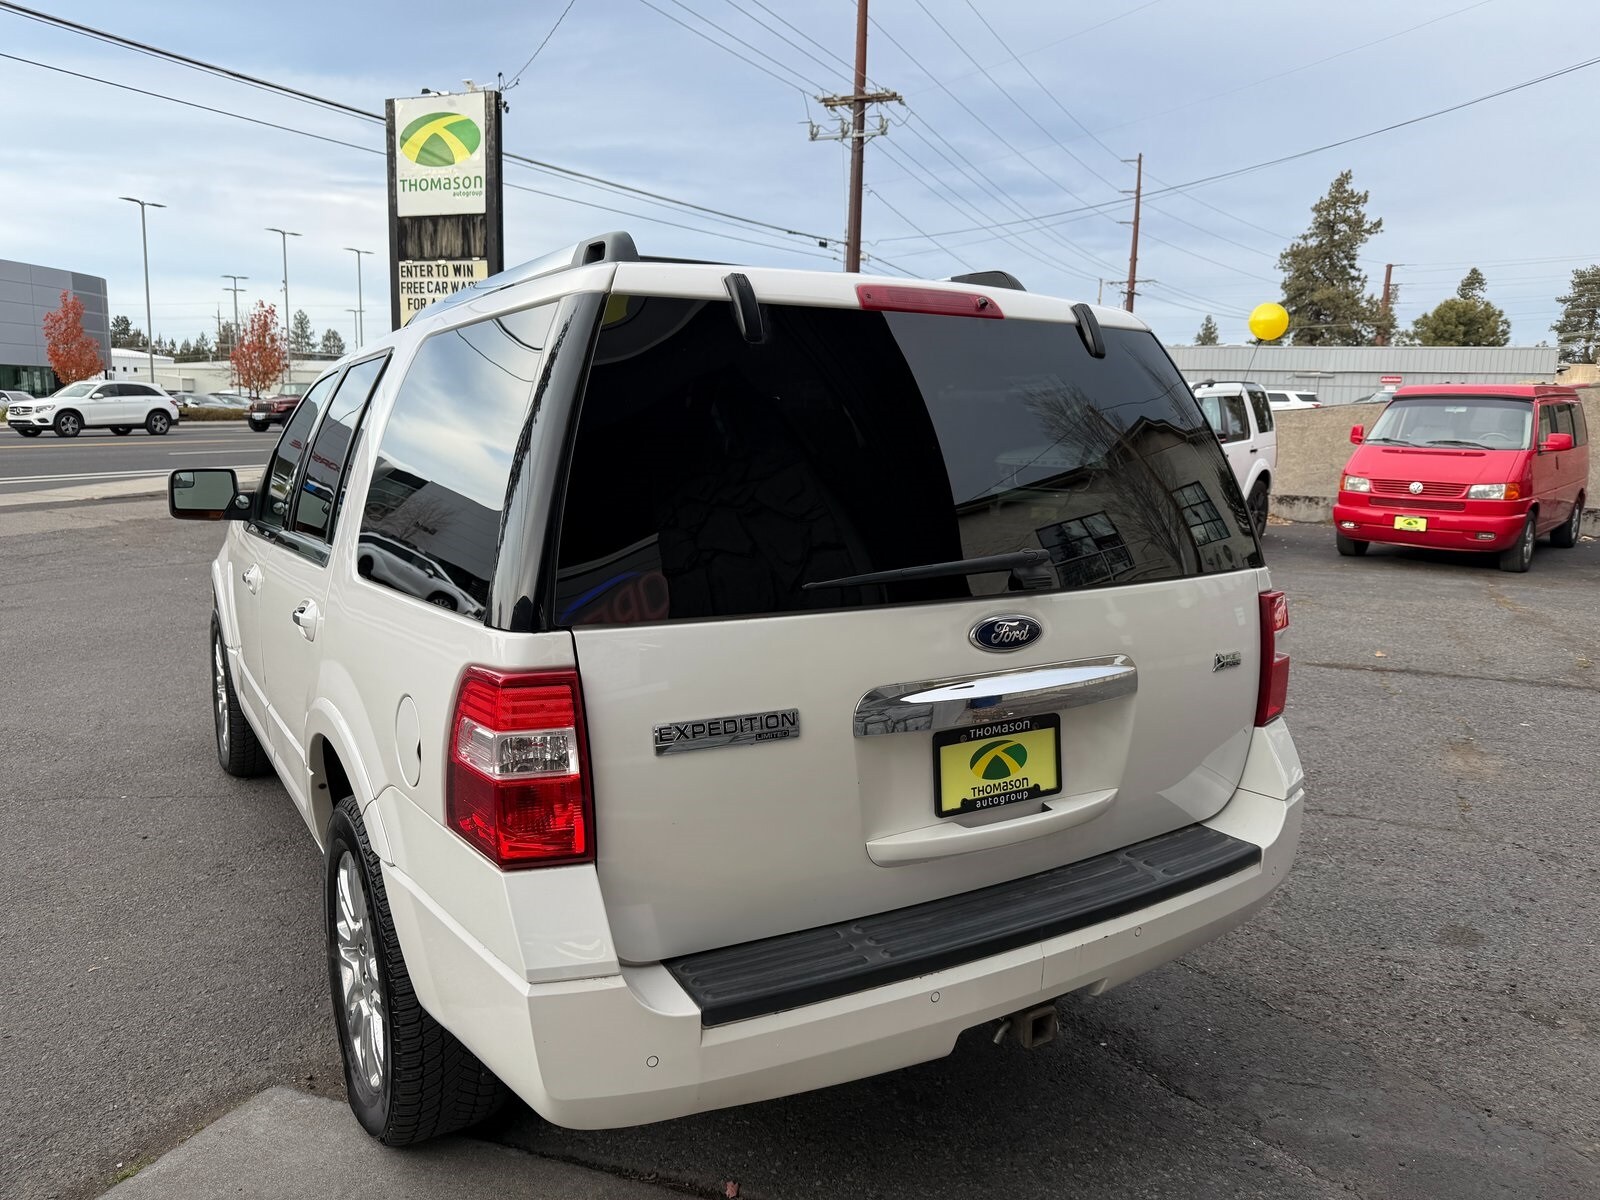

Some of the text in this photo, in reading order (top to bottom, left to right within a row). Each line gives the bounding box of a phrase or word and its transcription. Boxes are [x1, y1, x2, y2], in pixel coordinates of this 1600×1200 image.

[452, 190, 483, 198] autogroup
[400, 263, 474, 278] ENTER TO WIN
[400, 281, 425, 294] FREE
[426, 280, 449, 294] CAR
[407, 297, 427, 311] FOR
[990, 620, 1030, 645] Ford
[657, 711, 797, 743] EXPEDITION
[755, 729, 790, 741] LIMITED
[975, 790, 1029, 808] autogroup
